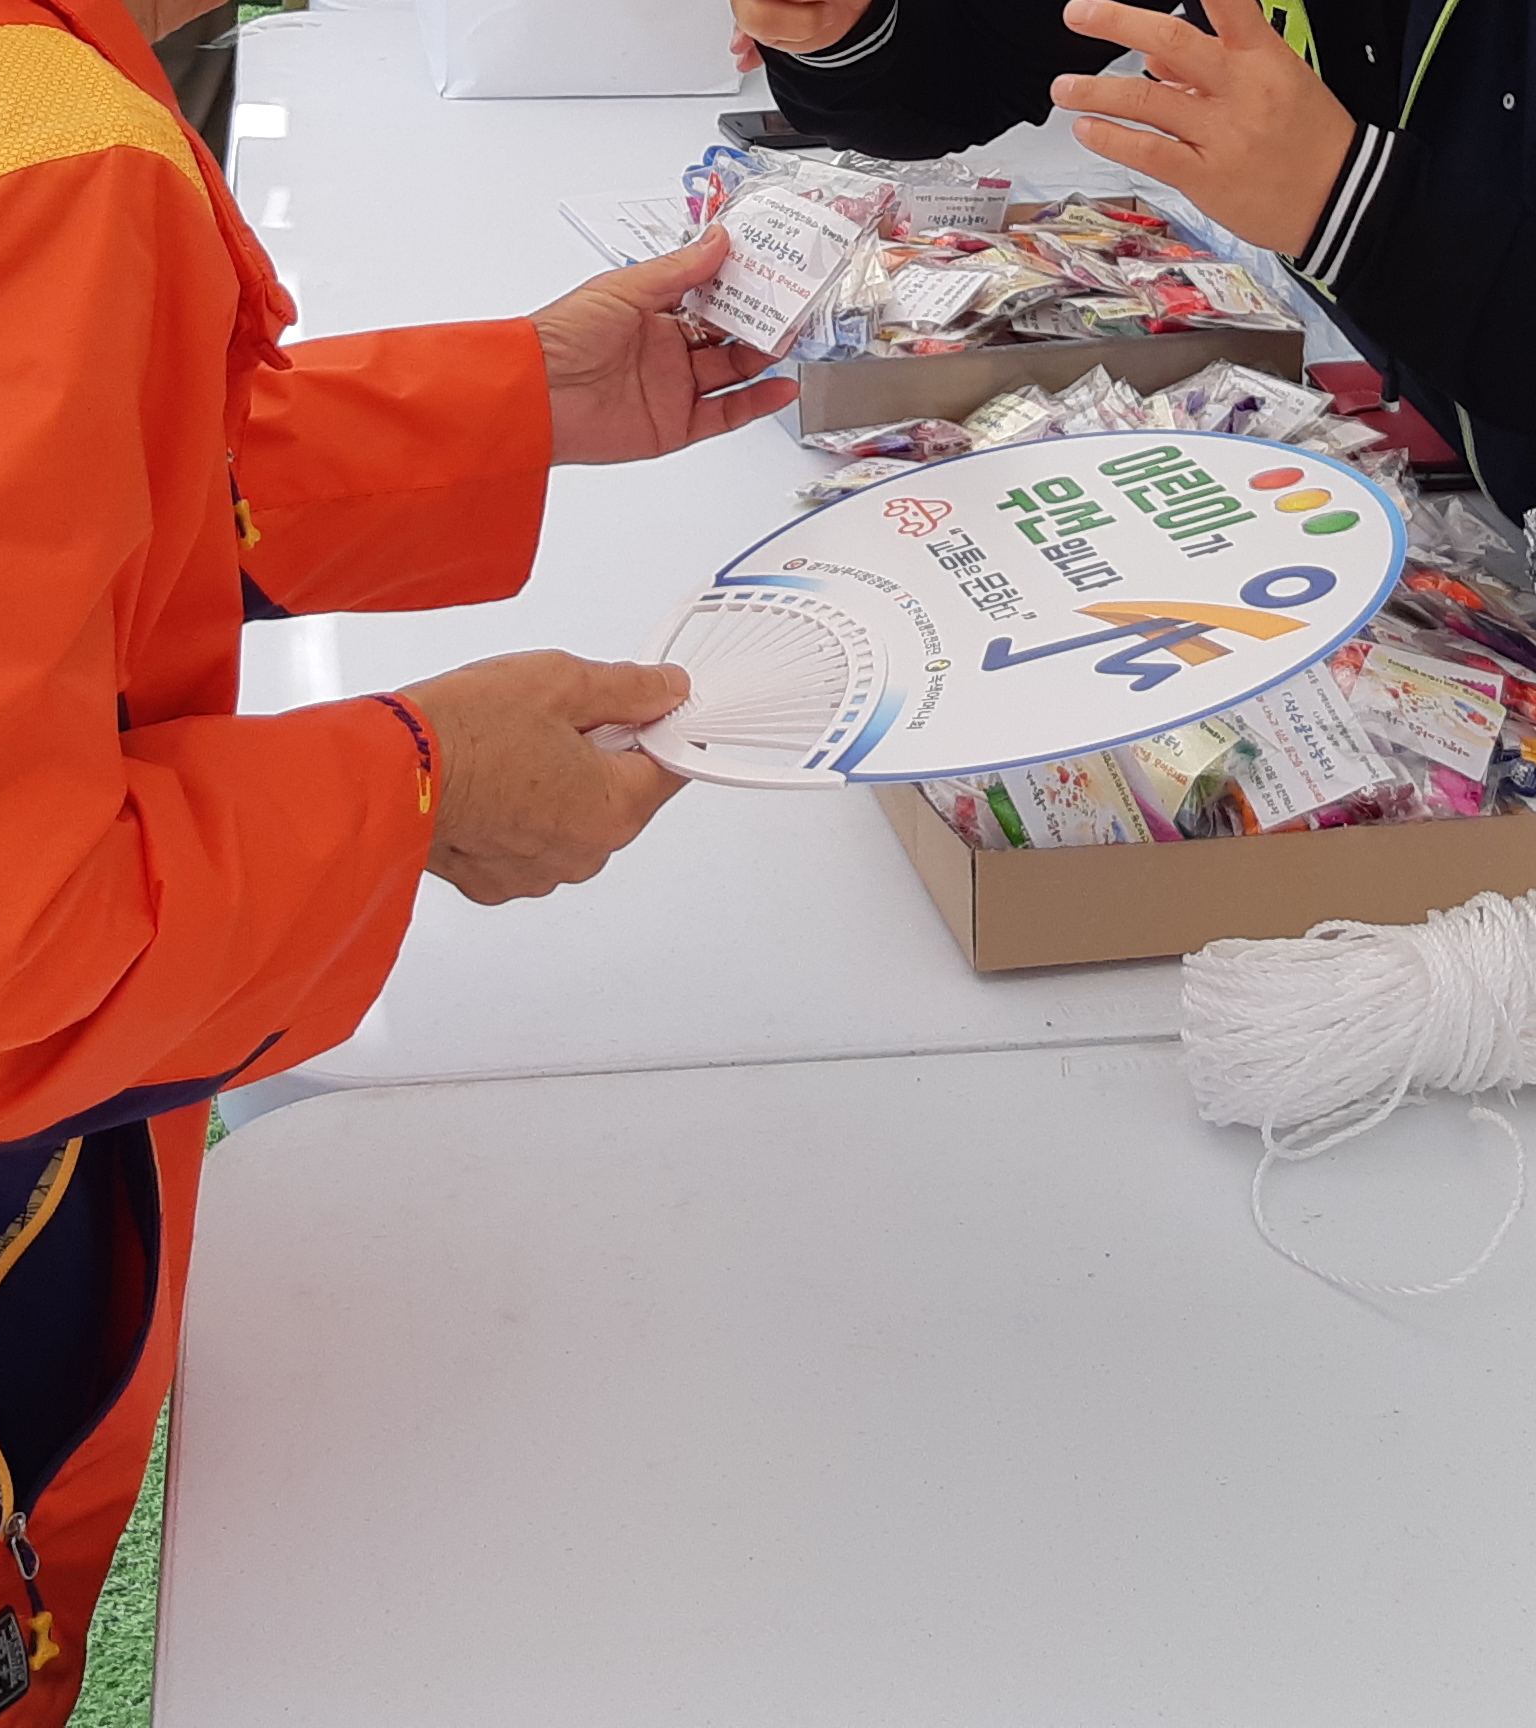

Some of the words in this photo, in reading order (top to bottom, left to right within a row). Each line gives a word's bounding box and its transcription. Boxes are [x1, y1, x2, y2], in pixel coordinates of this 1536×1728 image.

[725, 248, 744, 263] 누고
[997, 476, 1123, 592] 우선입니다
[1099, 445, 1257, 558] 어린이가
